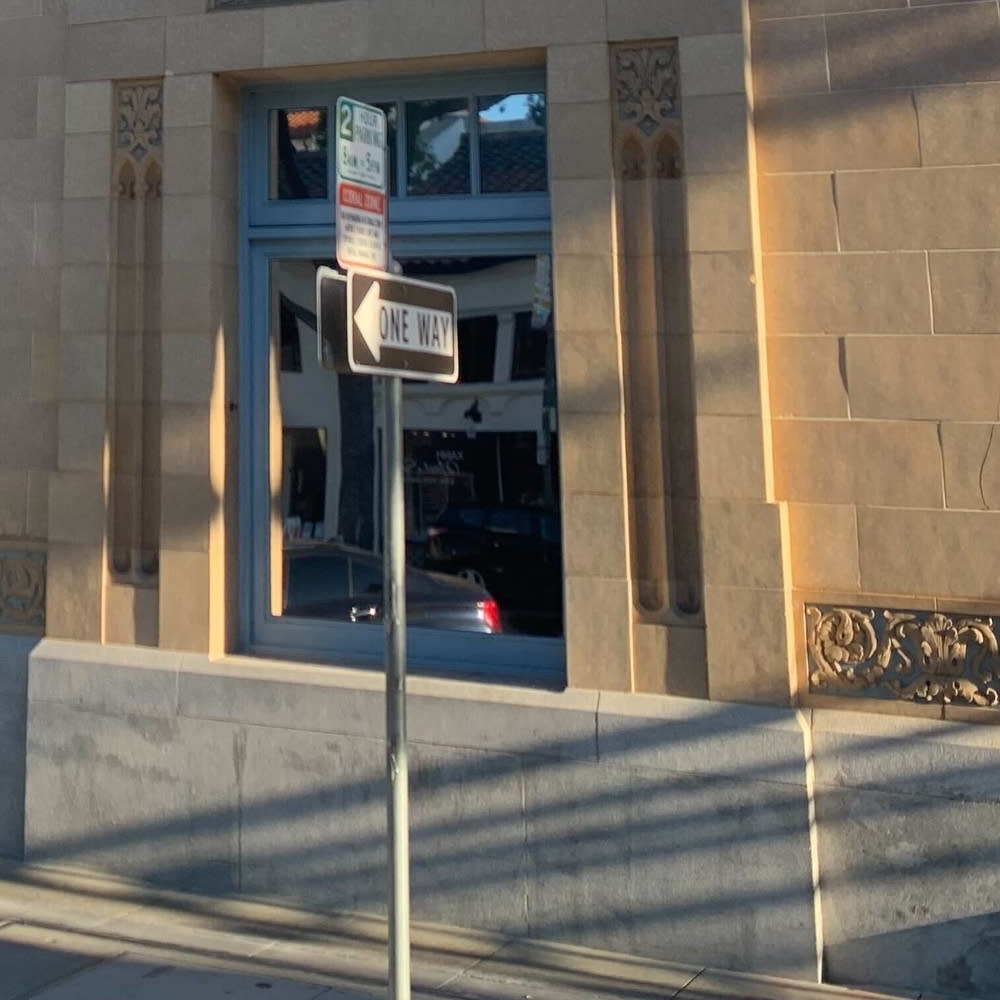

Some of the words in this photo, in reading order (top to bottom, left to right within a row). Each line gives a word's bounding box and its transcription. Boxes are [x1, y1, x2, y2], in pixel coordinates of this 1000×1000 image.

[341, 103, 352, 137] 2
[379, 306, 408, 342] ONE
[417, 311, 449, 349] WAY
